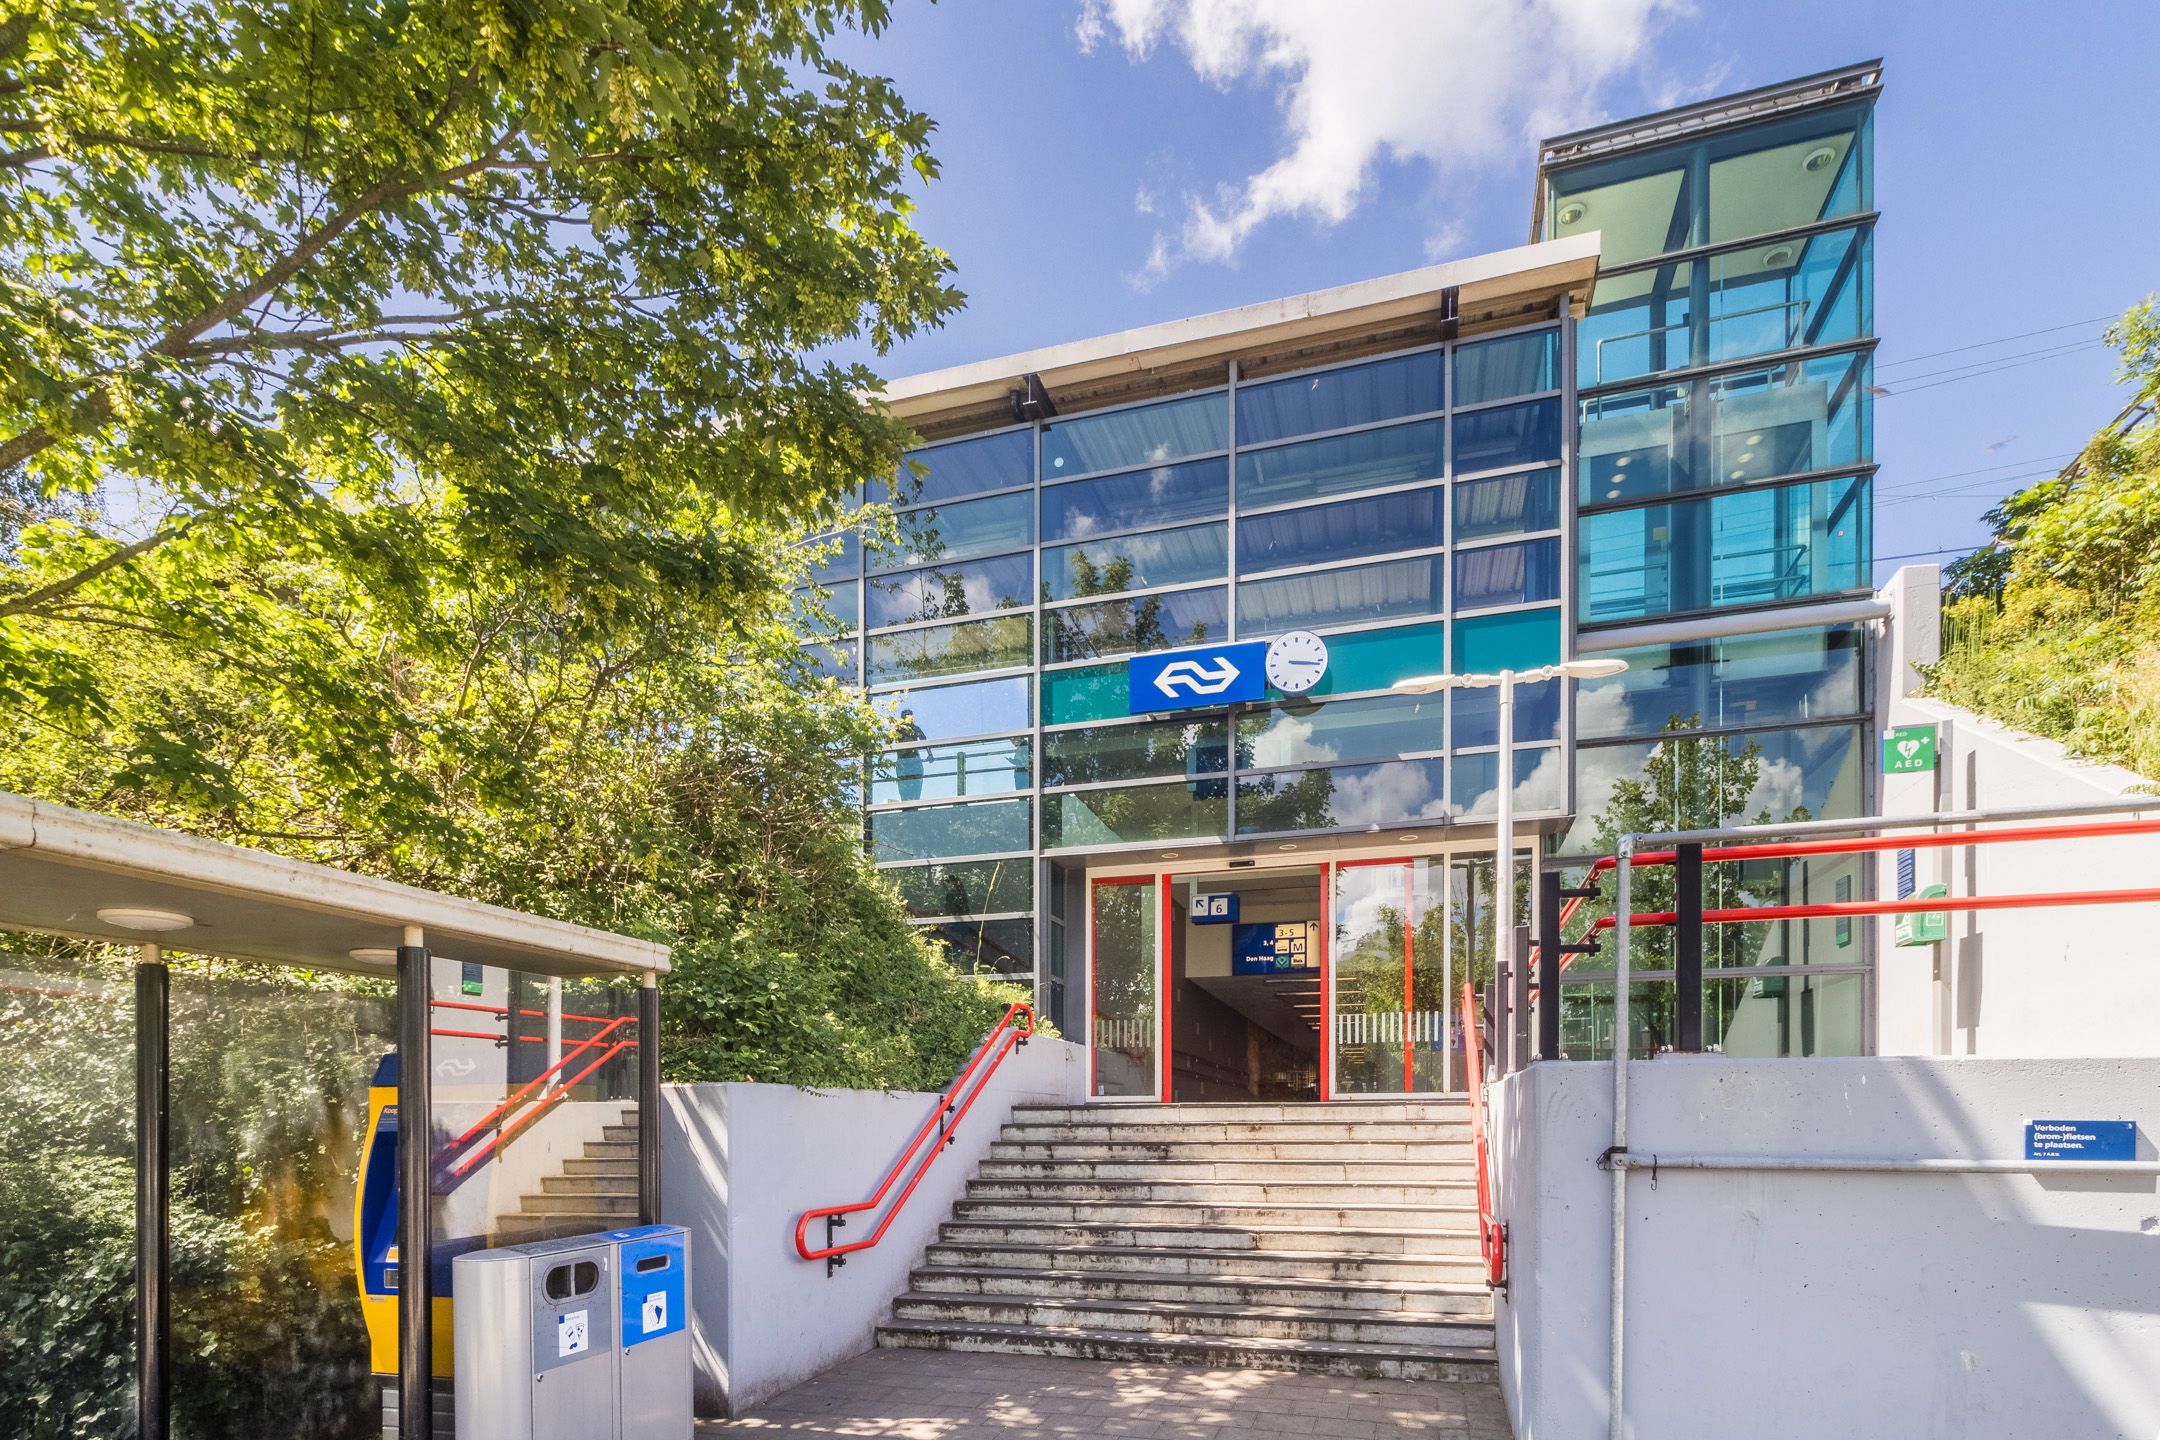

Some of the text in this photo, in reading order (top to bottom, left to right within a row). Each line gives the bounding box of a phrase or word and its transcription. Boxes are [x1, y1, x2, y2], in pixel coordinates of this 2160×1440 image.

[1894, 759, 1923, 769] AED
[1216, 904, 1222, 913] 6
[1293, 943, 1303, 951] M
[2034, 1133, 2096, 1141] (brom-)fietsen
[2045, 1141, 2085, 1149] plaatsen.
